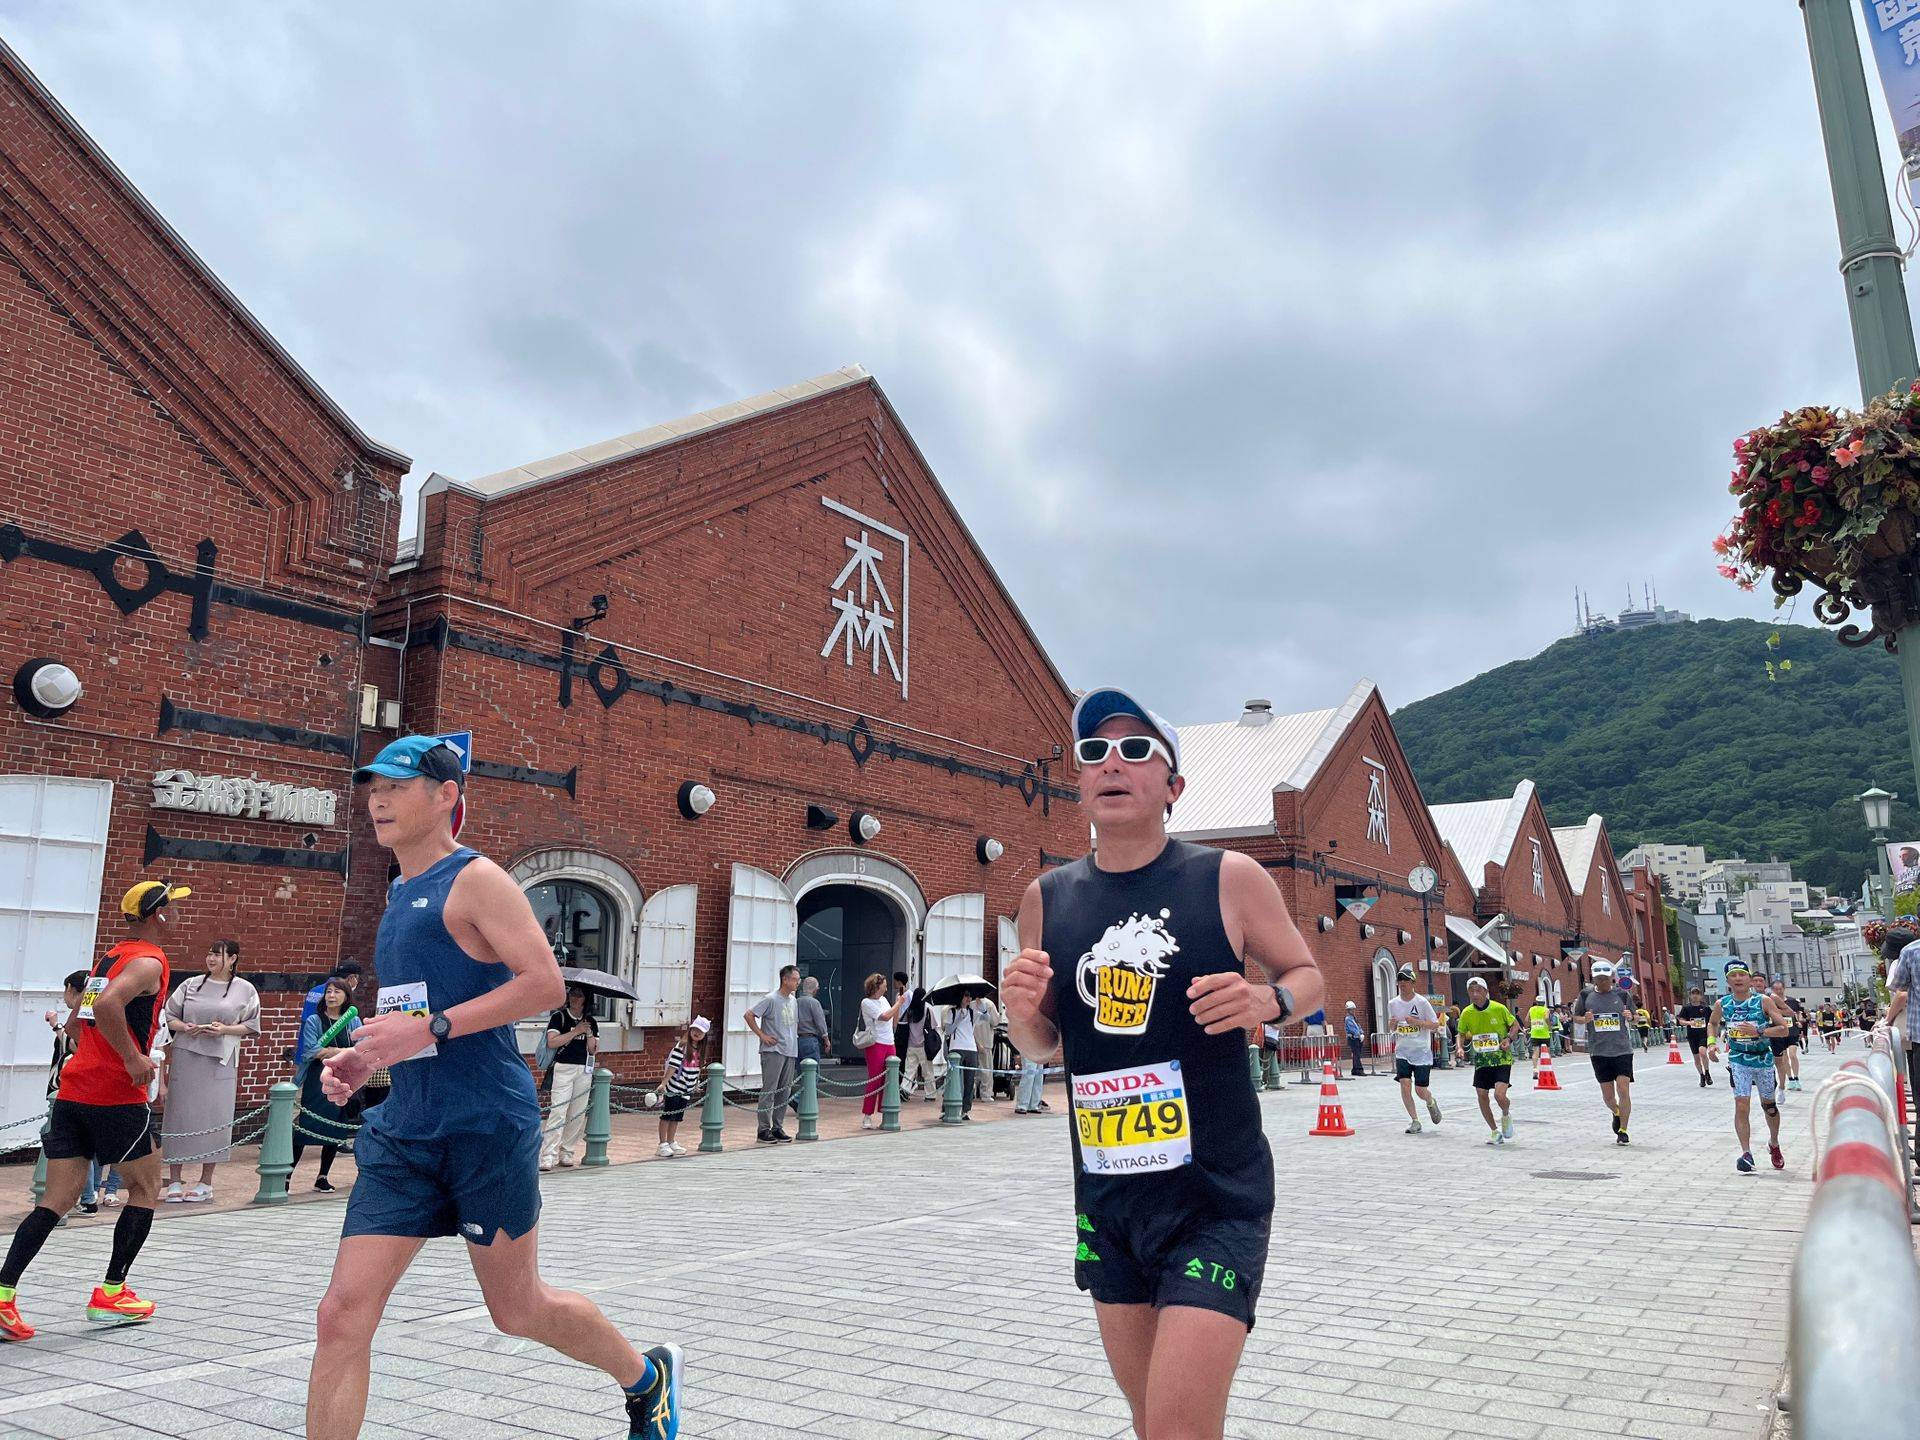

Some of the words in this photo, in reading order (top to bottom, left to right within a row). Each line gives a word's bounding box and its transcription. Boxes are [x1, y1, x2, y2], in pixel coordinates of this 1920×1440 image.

[853, 856, 866, 873] 15
[1099, 965, 1152, 1000] RUN&
[1099, 994, 1147, 1027] BEER
[1075, 1072, 1164, 1095] HONDA
[1112, 1154, 1169, 1169] KITAGAS
[1210, 1261, 1237, 1290] T8
